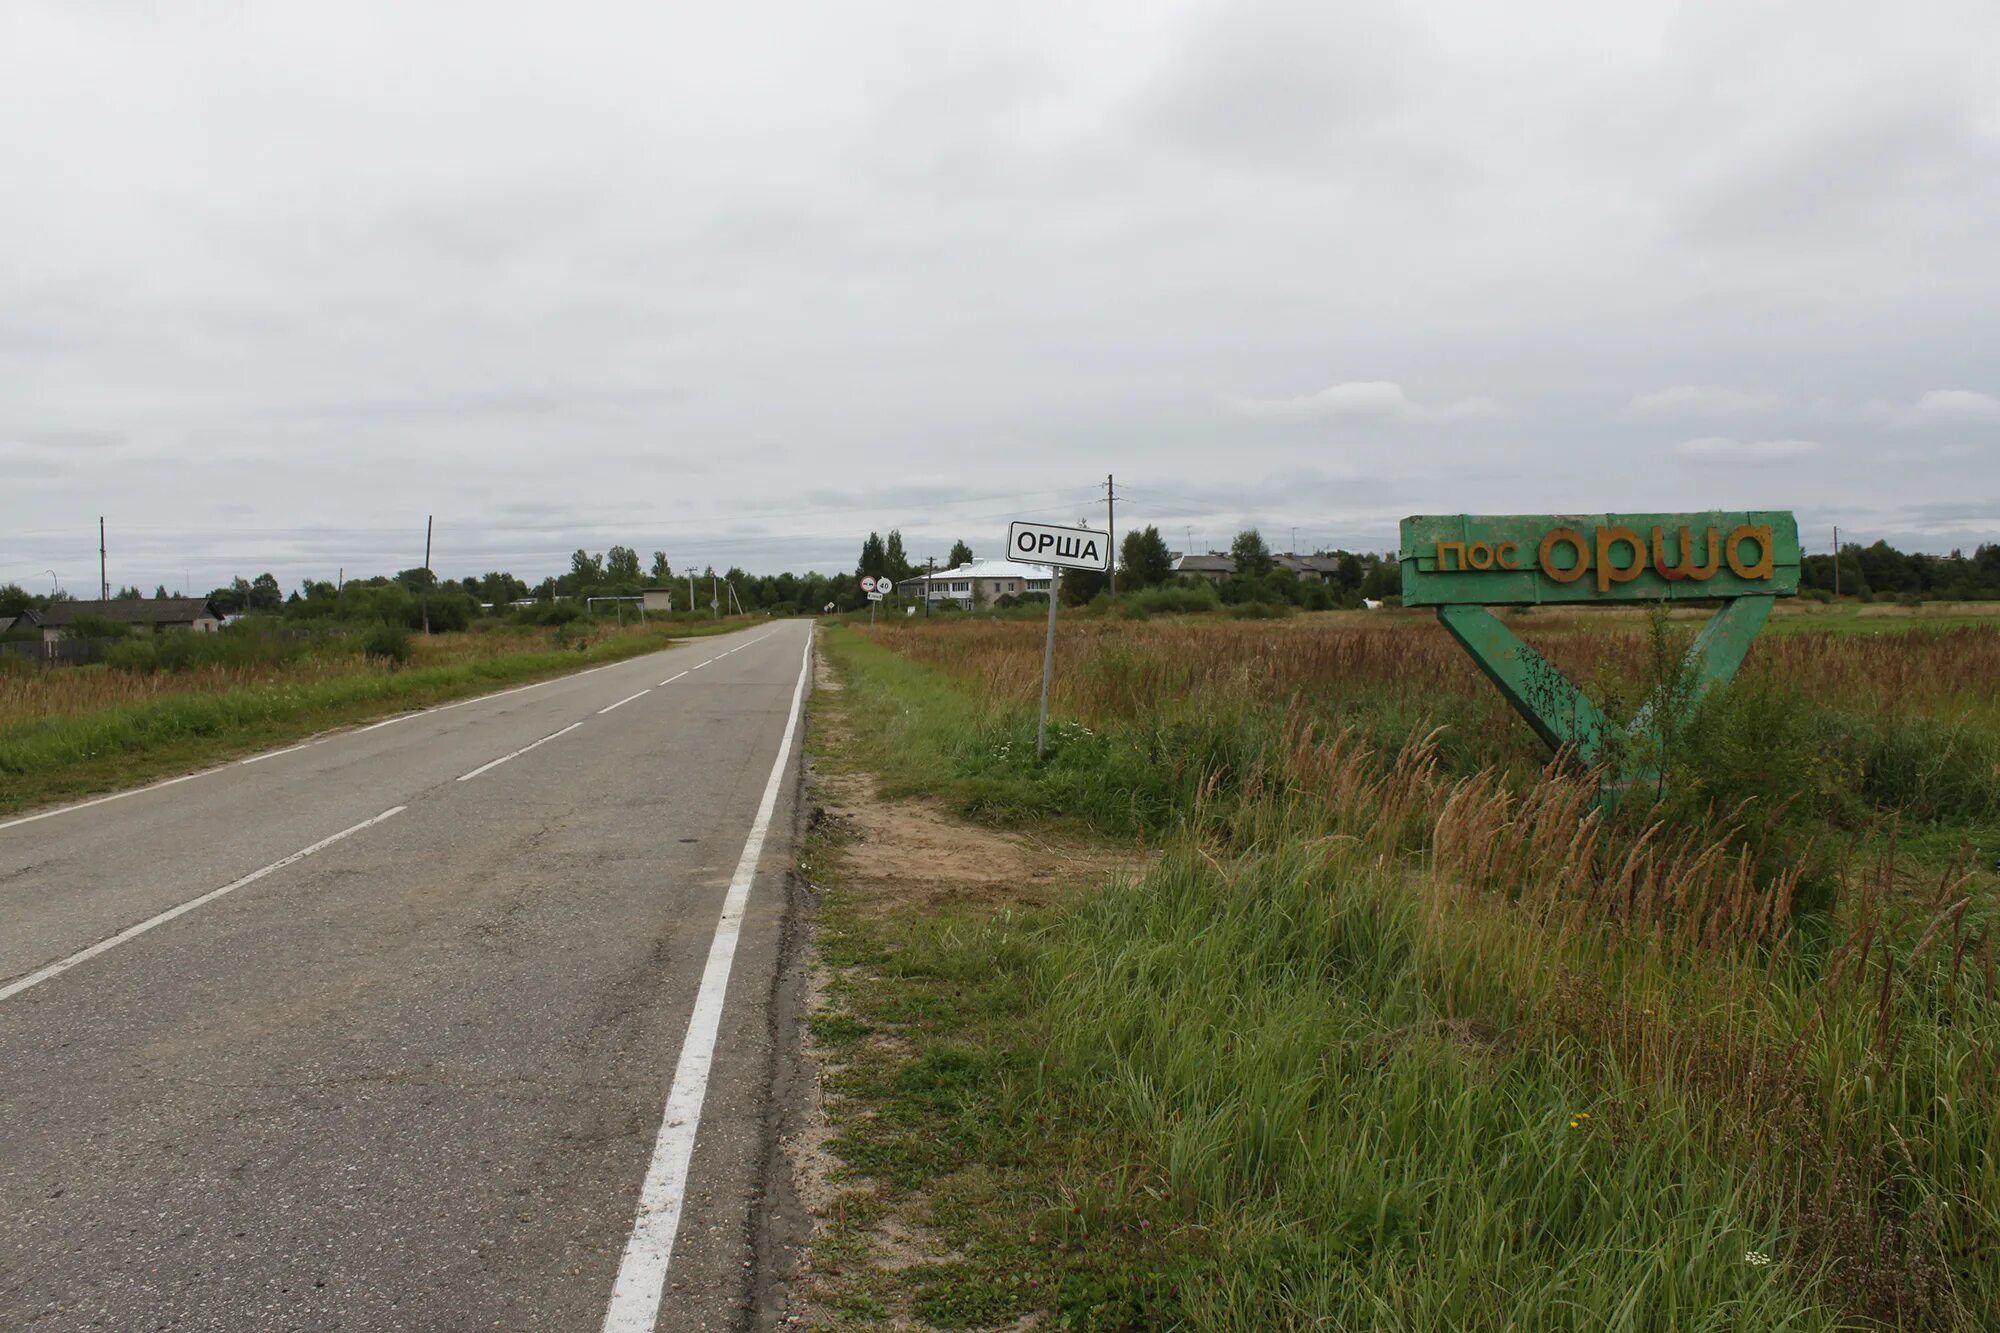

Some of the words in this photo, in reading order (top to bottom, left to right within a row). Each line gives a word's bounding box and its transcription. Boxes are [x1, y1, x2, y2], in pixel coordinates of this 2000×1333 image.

[1017, 531, 1099, 561] ОРША
[1437, 541, 1520, 571] пос
[1539, 525, 1774, 592] орша
